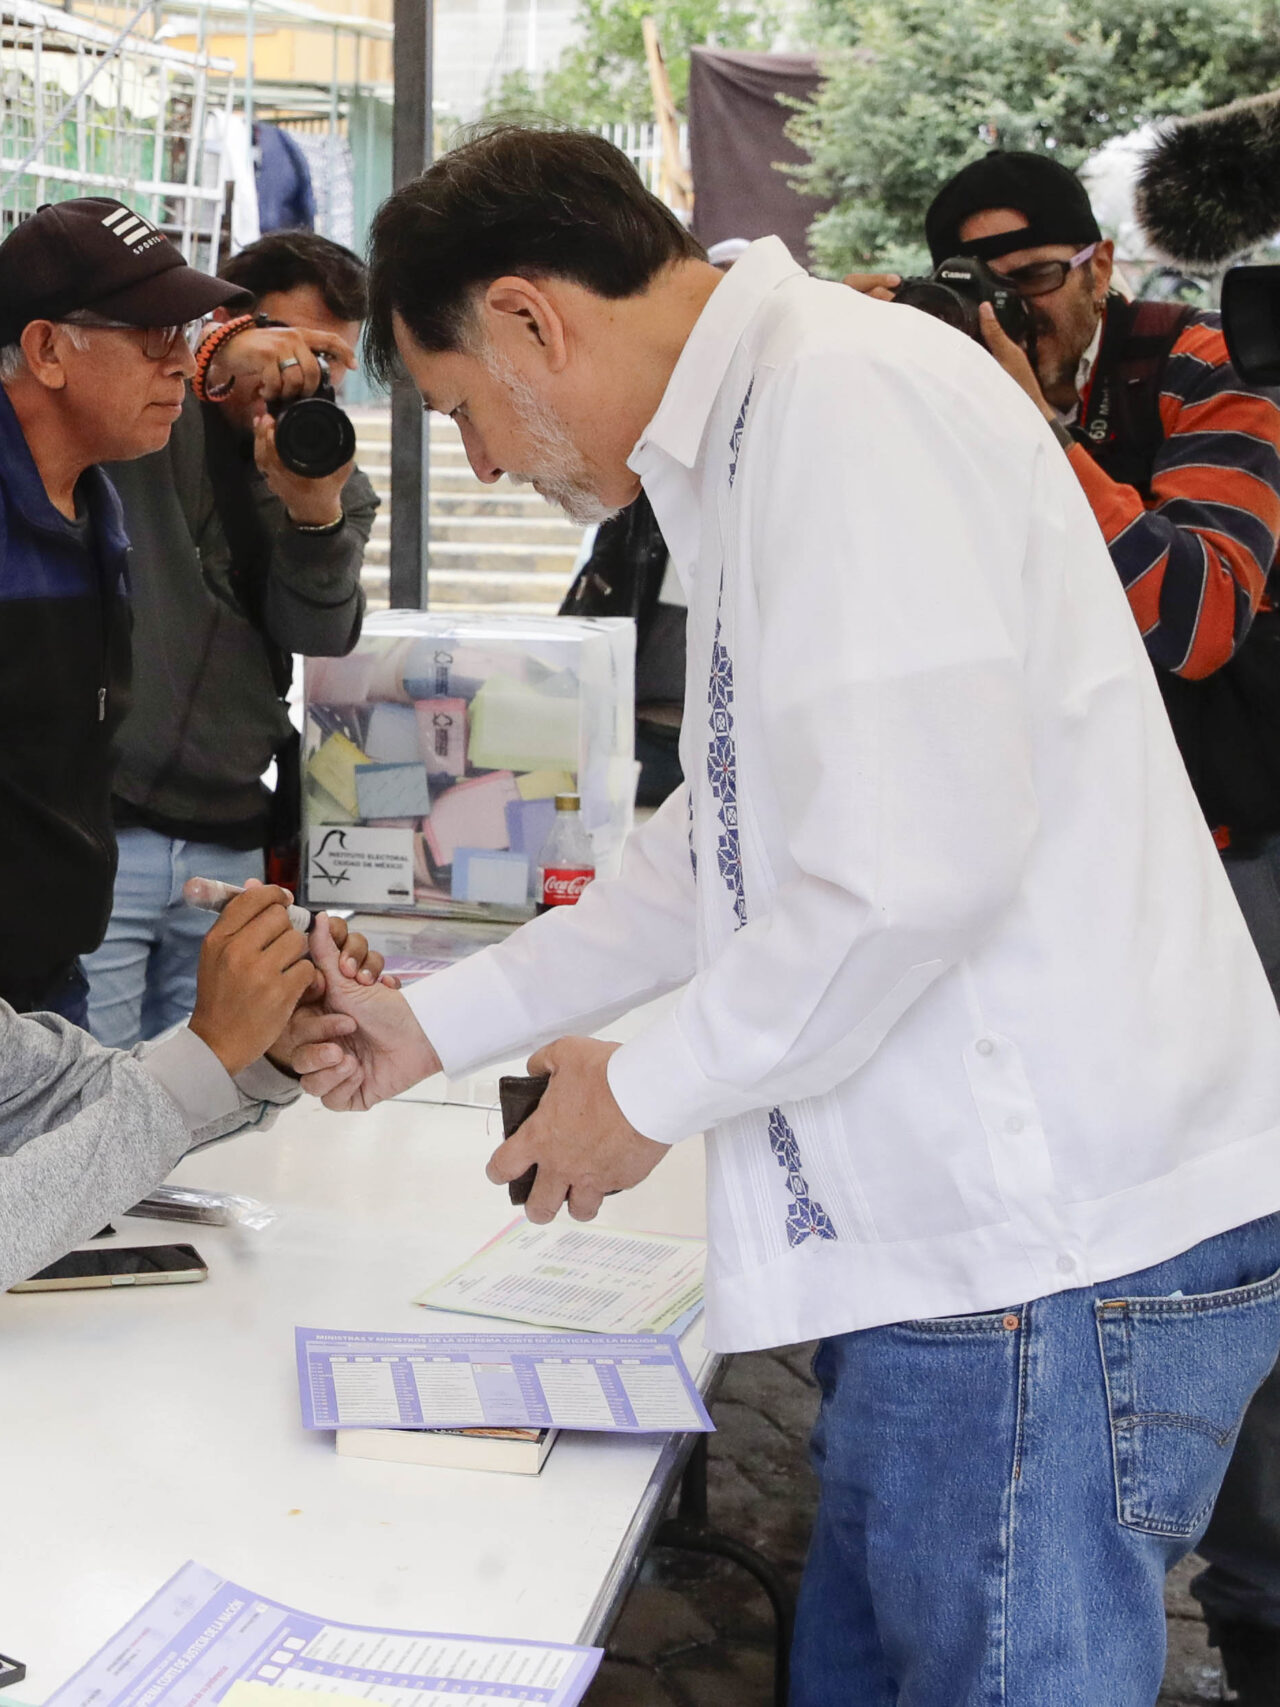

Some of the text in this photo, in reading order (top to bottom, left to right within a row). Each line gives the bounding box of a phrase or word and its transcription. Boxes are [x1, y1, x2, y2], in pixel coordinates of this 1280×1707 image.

[941, 269, 972, 280] Canon
[315, 1334, 367, 1343] MINISTRAS
[375, 1336, 426, 1344] MINISTROS
[620, 1336, 658, 1344] NACIÓN
[180, 1634, 211, 1662] JUSTICIA
[216, 1598, 247, 1624] NACIÓN
